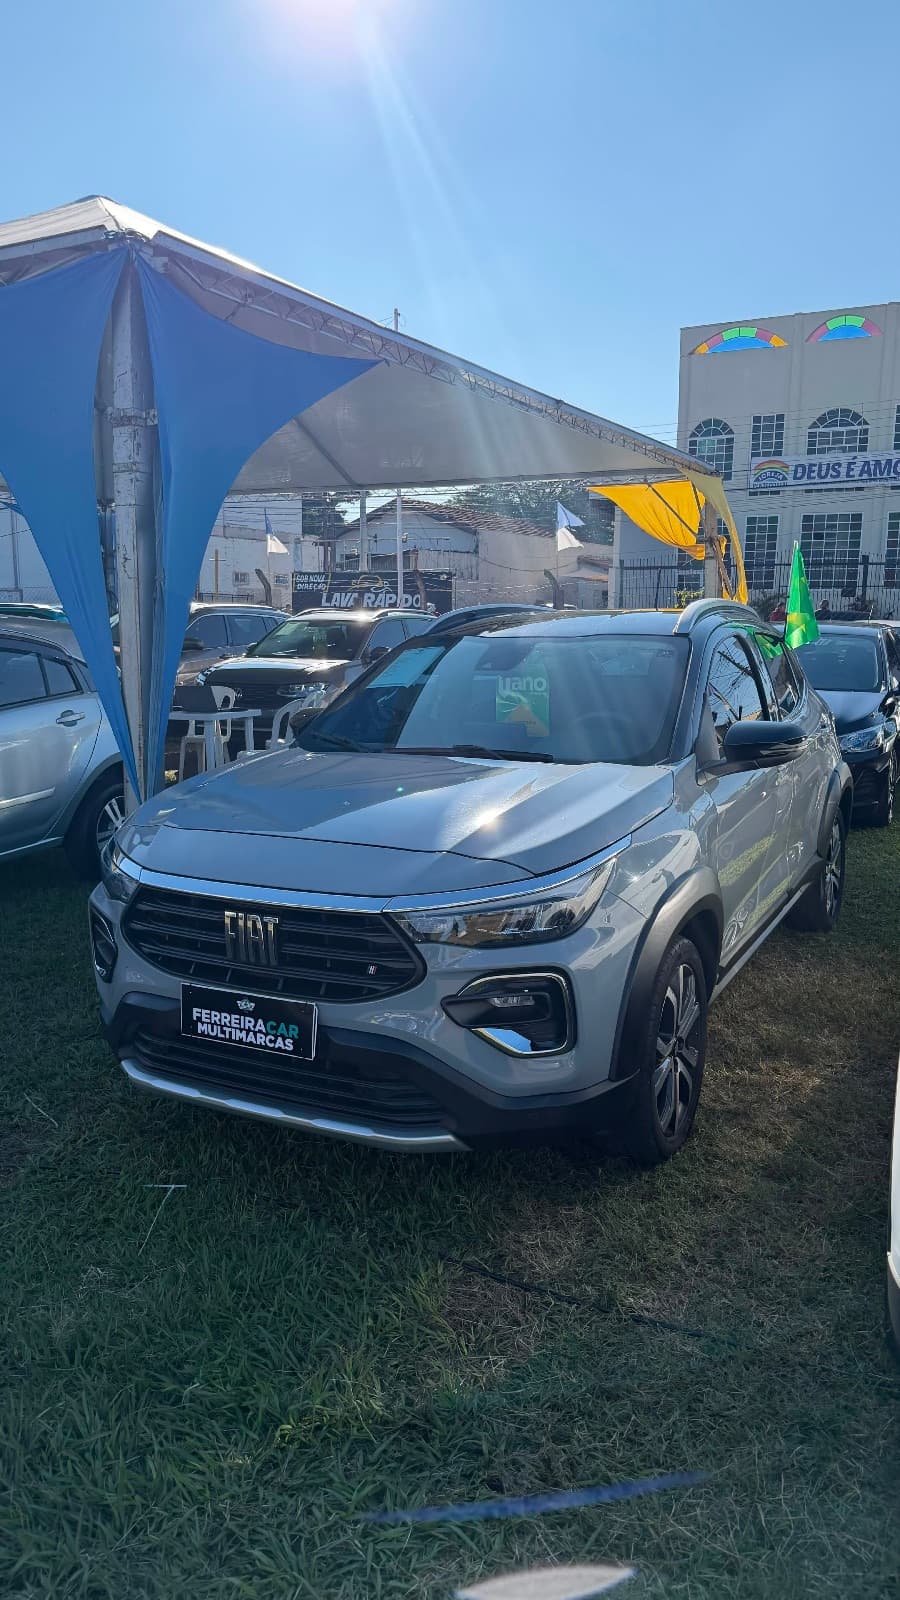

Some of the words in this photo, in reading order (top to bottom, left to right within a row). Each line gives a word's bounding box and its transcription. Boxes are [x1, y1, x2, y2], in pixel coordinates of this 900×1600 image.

[792, 462, 842, 481] DEUS
[846, 456, 857, 478] É
[224, 911, 279, 965] FIAT
[197, 1022, 294, 1051] MULTIMARCAS
